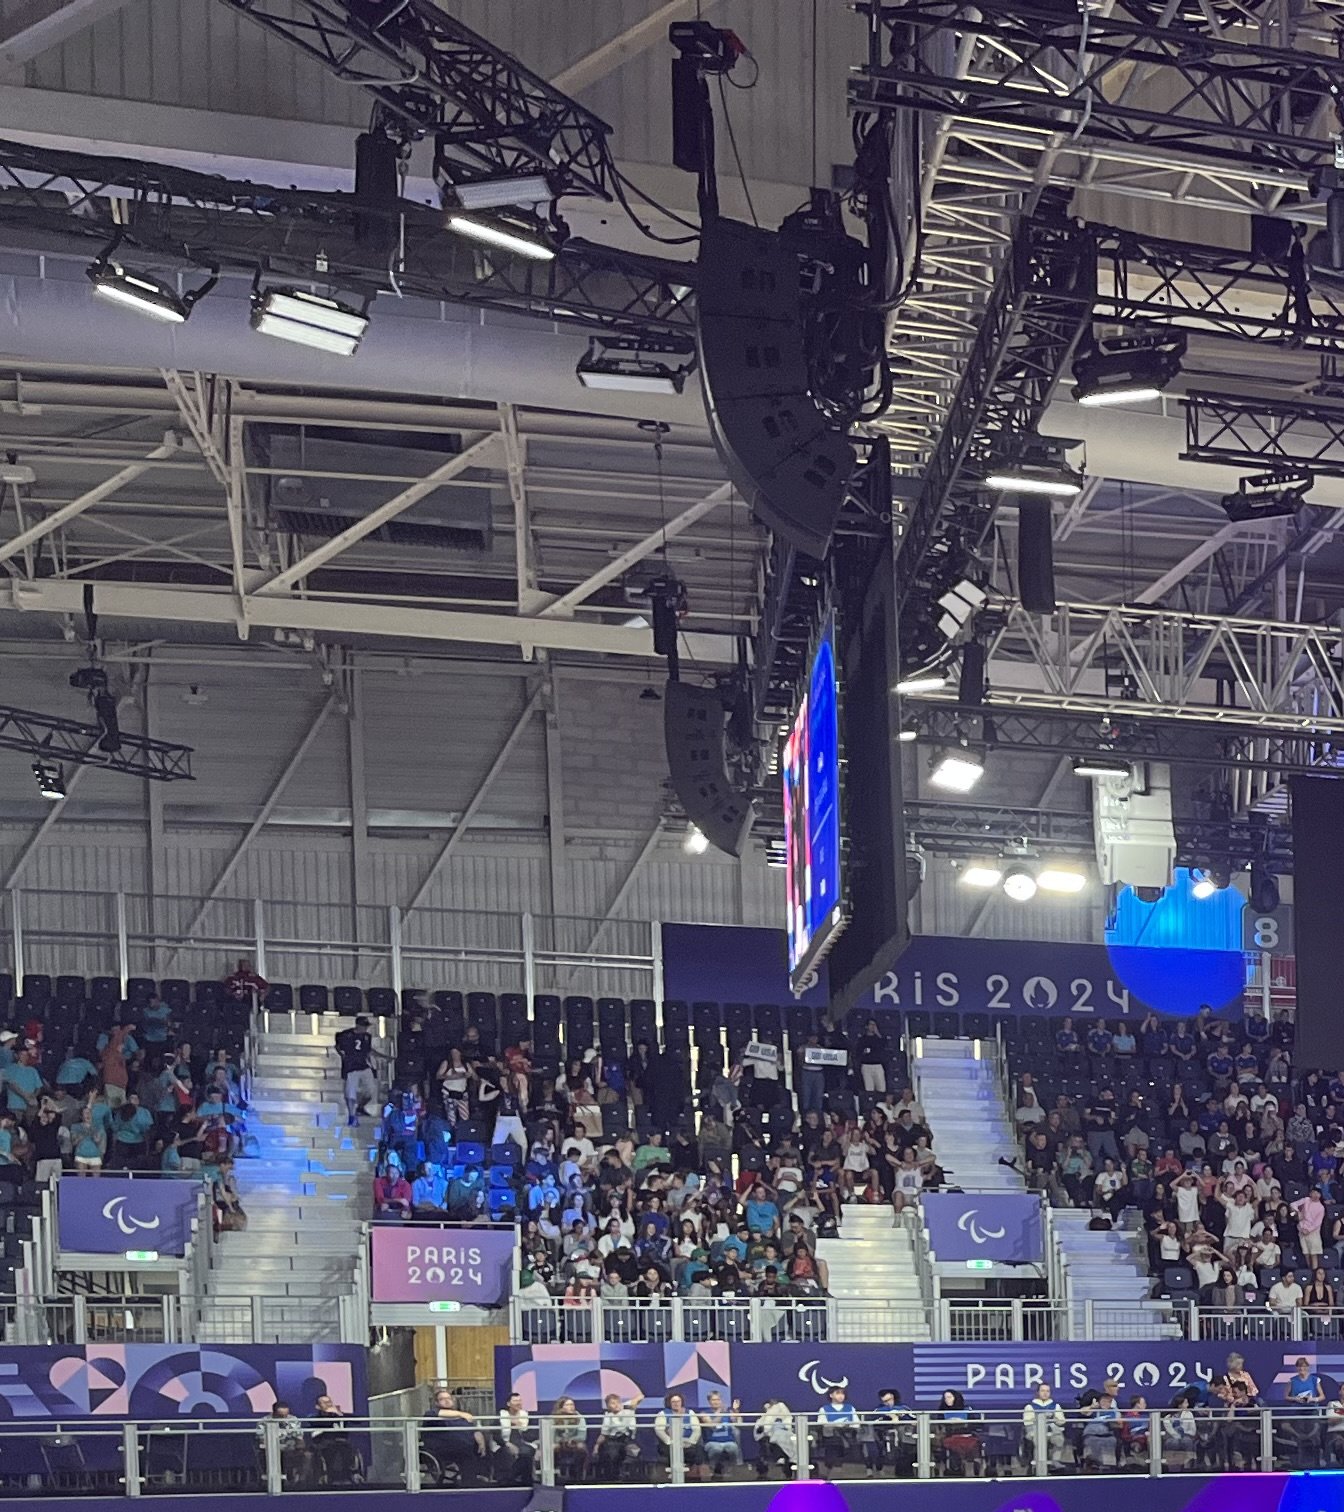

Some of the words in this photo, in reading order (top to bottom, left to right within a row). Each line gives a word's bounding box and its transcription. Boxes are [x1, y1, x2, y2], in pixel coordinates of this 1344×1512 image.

[1253, 917, 1279, 948] 8
[987, 974, 1131, 1013] 2024
[407, 1246, 482, 1266] PARIS
[408, 1266, 483, 1287] 2024
[966, 1363, 1089, 1390] PARIS
[1106, 1361, 1214, 1390] 2024
